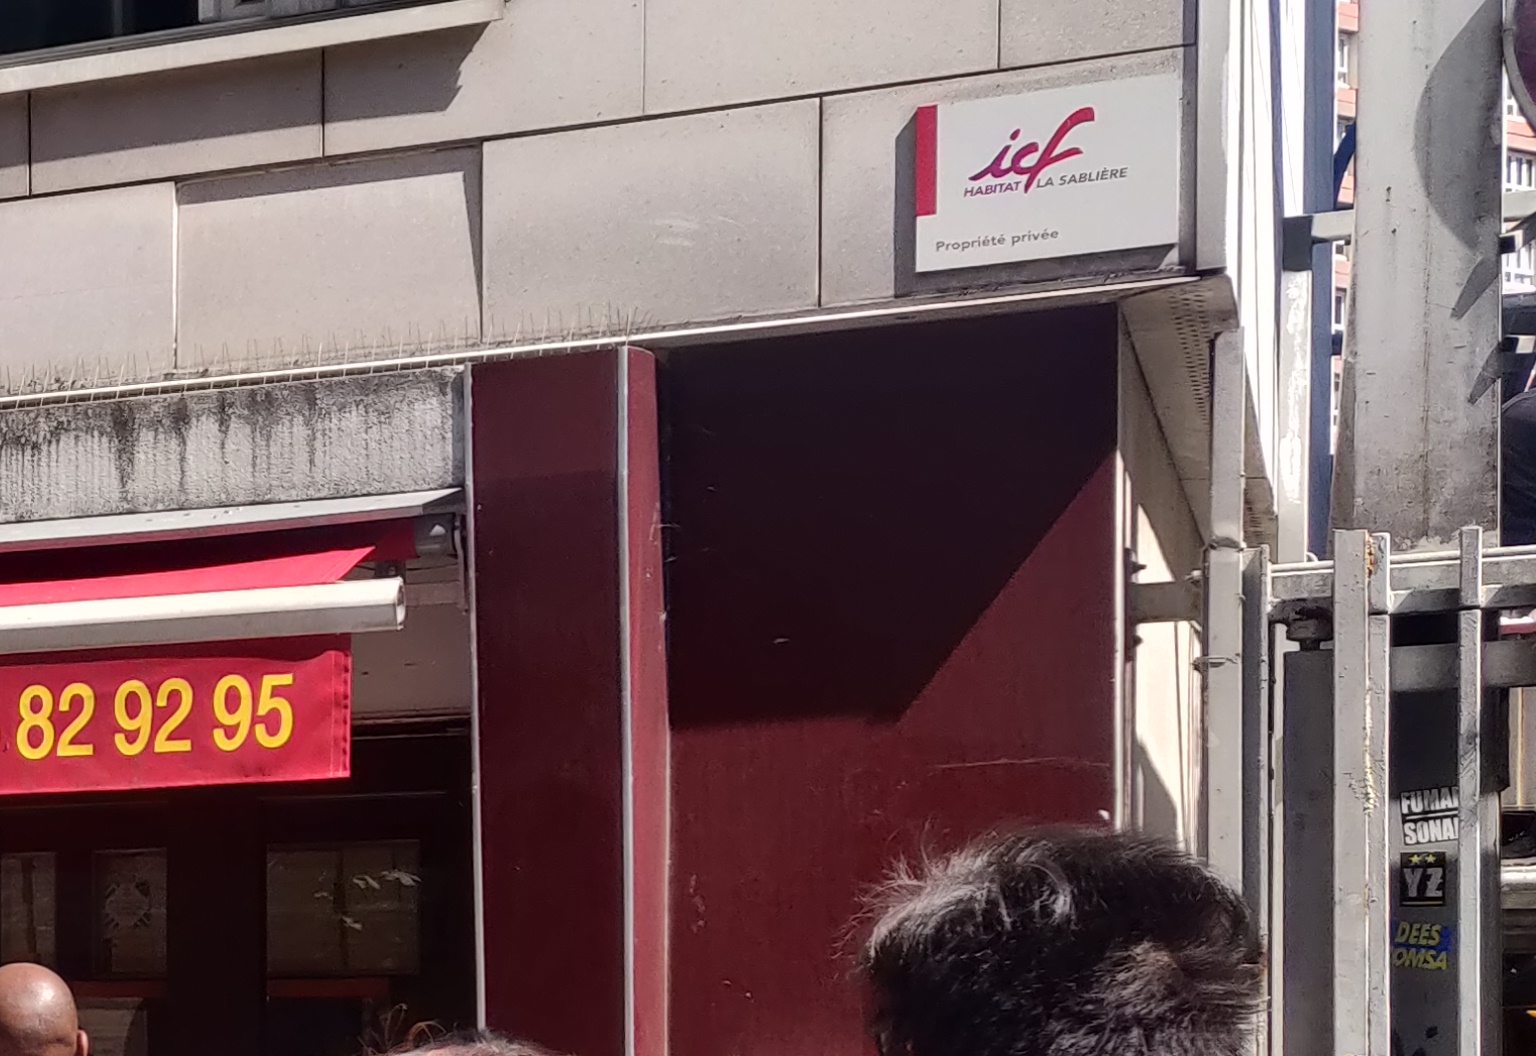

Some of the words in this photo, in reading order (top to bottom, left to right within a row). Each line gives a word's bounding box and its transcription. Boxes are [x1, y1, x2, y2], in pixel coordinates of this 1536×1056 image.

[968, 107, 1095, 194] icf
[963, 181, 1022, 197] HABITAT
[1035, 177, 1055, 189] LA
[1058, 167, 1129, 186] SABLIÈRE
[935, 234, 1006, 252] Propriété
[1011, 228, 1060, 247] privée
[14, 682, 96, 761] 82
[113, 678, 194, 757] 92
[211, 672, 296, 752] 95
[1403, 817, 1459, 845] SONA
